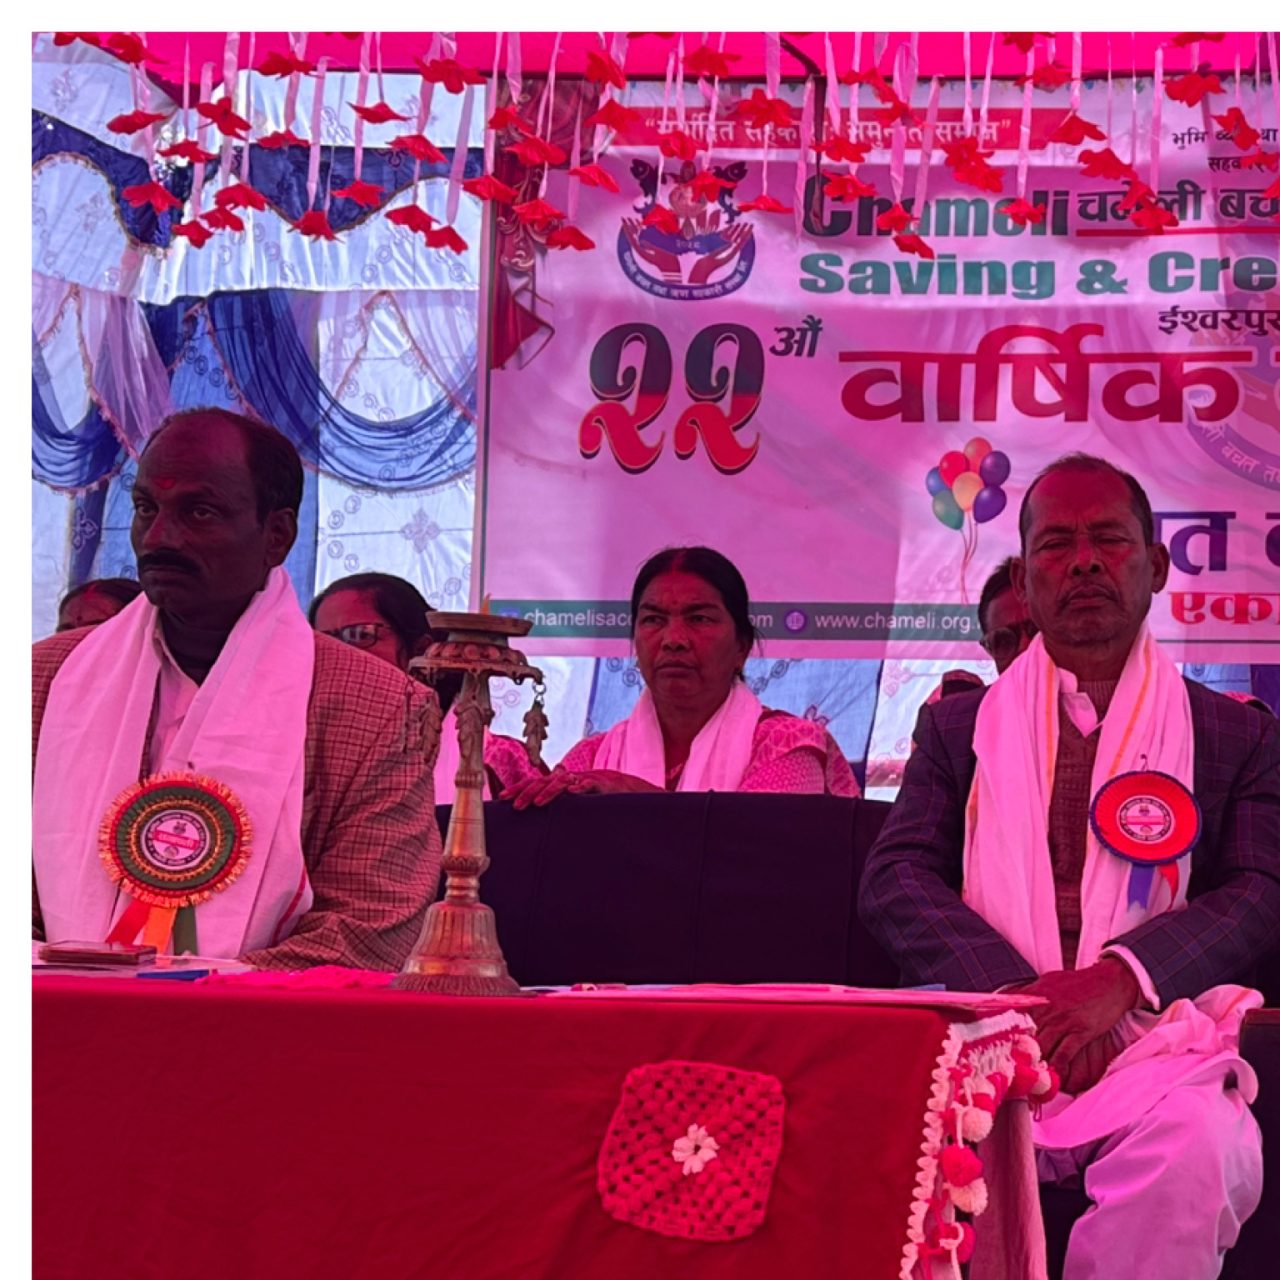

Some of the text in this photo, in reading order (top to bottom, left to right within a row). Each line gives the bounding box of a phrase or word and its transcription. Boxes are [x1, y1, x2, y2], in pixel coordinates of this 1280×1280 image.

[799, 252, 1056, 300] Saving
[1077, 258, 1129, 295] &
[578, 321, 766, 476] २२
[839, 323, 1253, 424] वार्षिक
